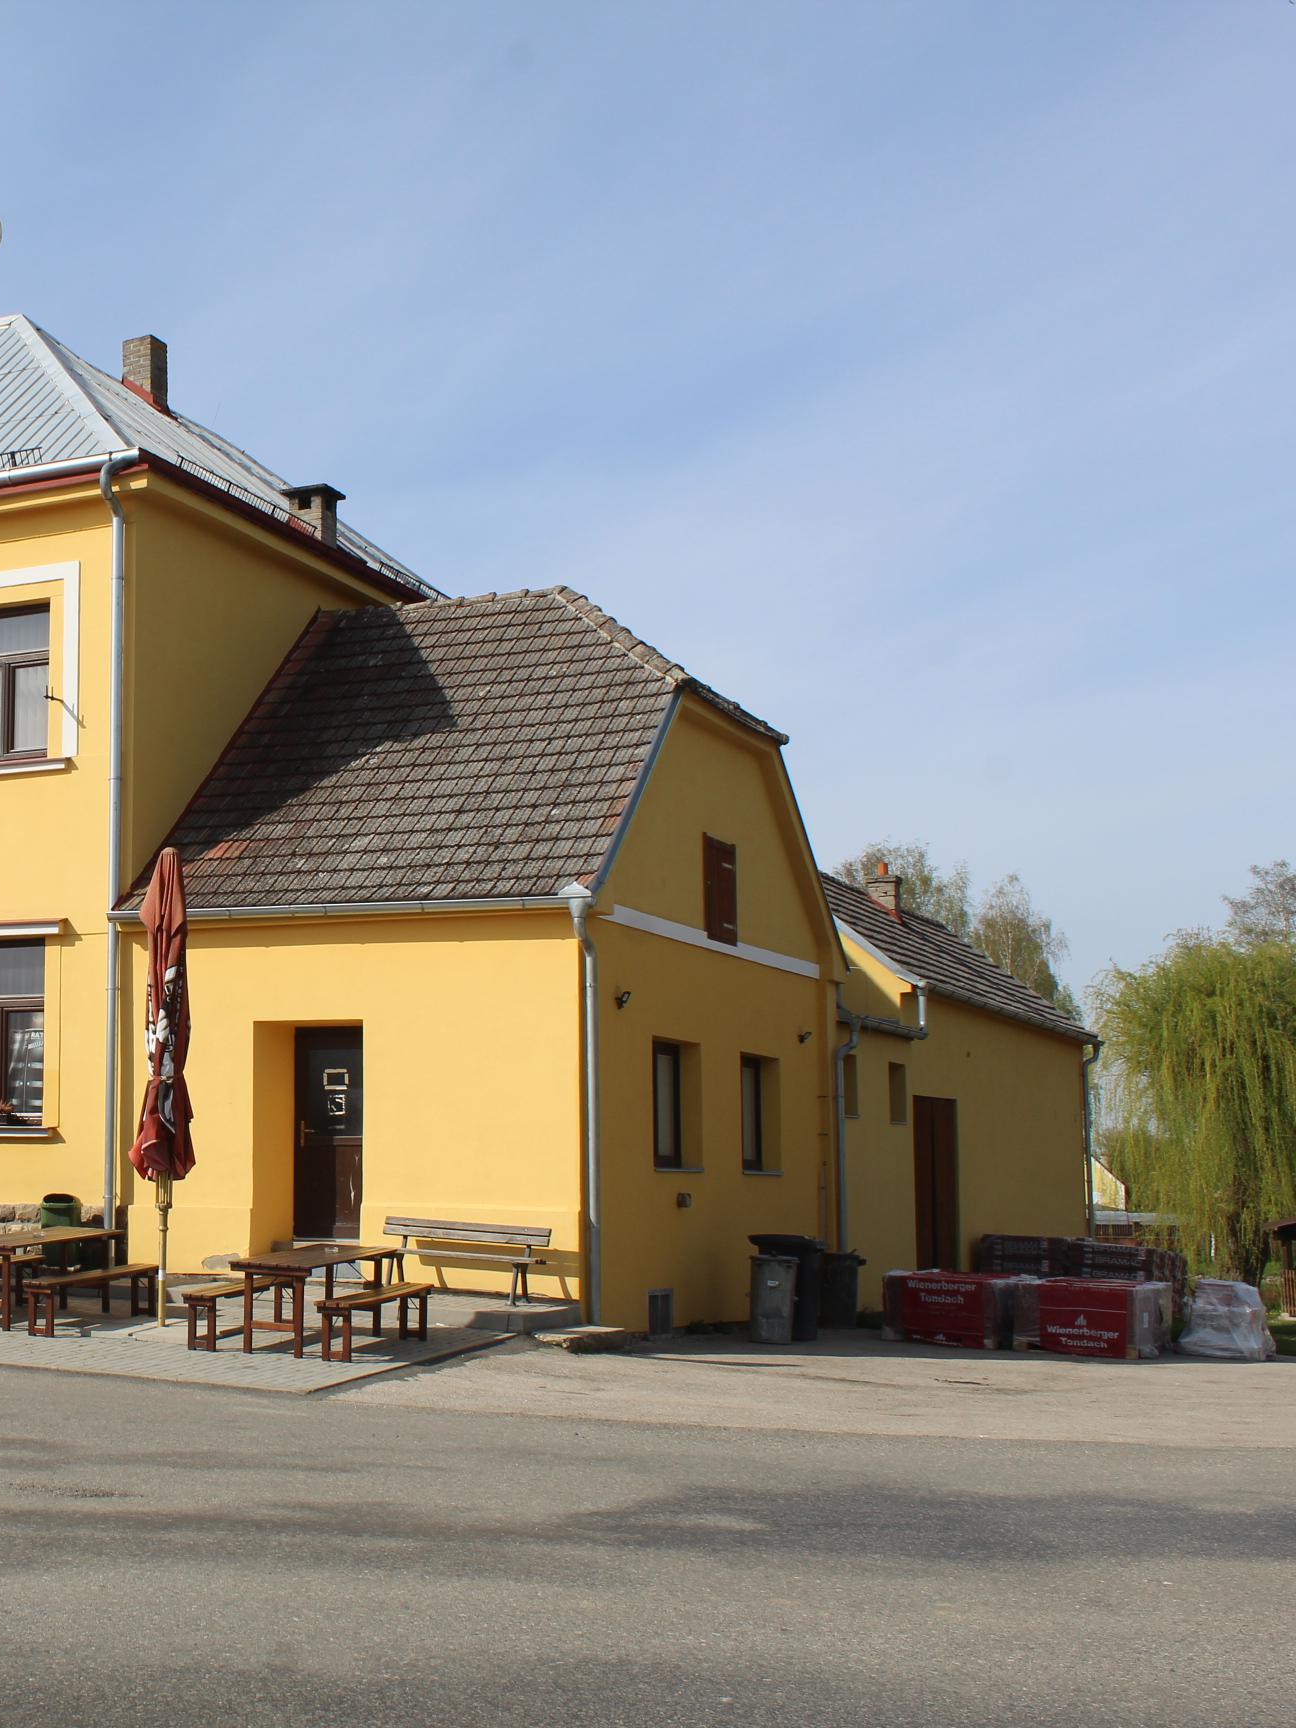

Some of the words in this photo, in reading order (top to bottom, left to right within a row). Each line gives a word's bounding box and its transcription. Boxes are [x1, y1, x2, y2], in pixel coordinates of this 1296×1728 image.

[906, 1280, 977, 1292] Wienerberger
[920, 1293, 964, 1304] Tondach
[1046, 1324, 1120, 1340] Wienerberger
[1060, 1337, 1108, 1348] Tondach
